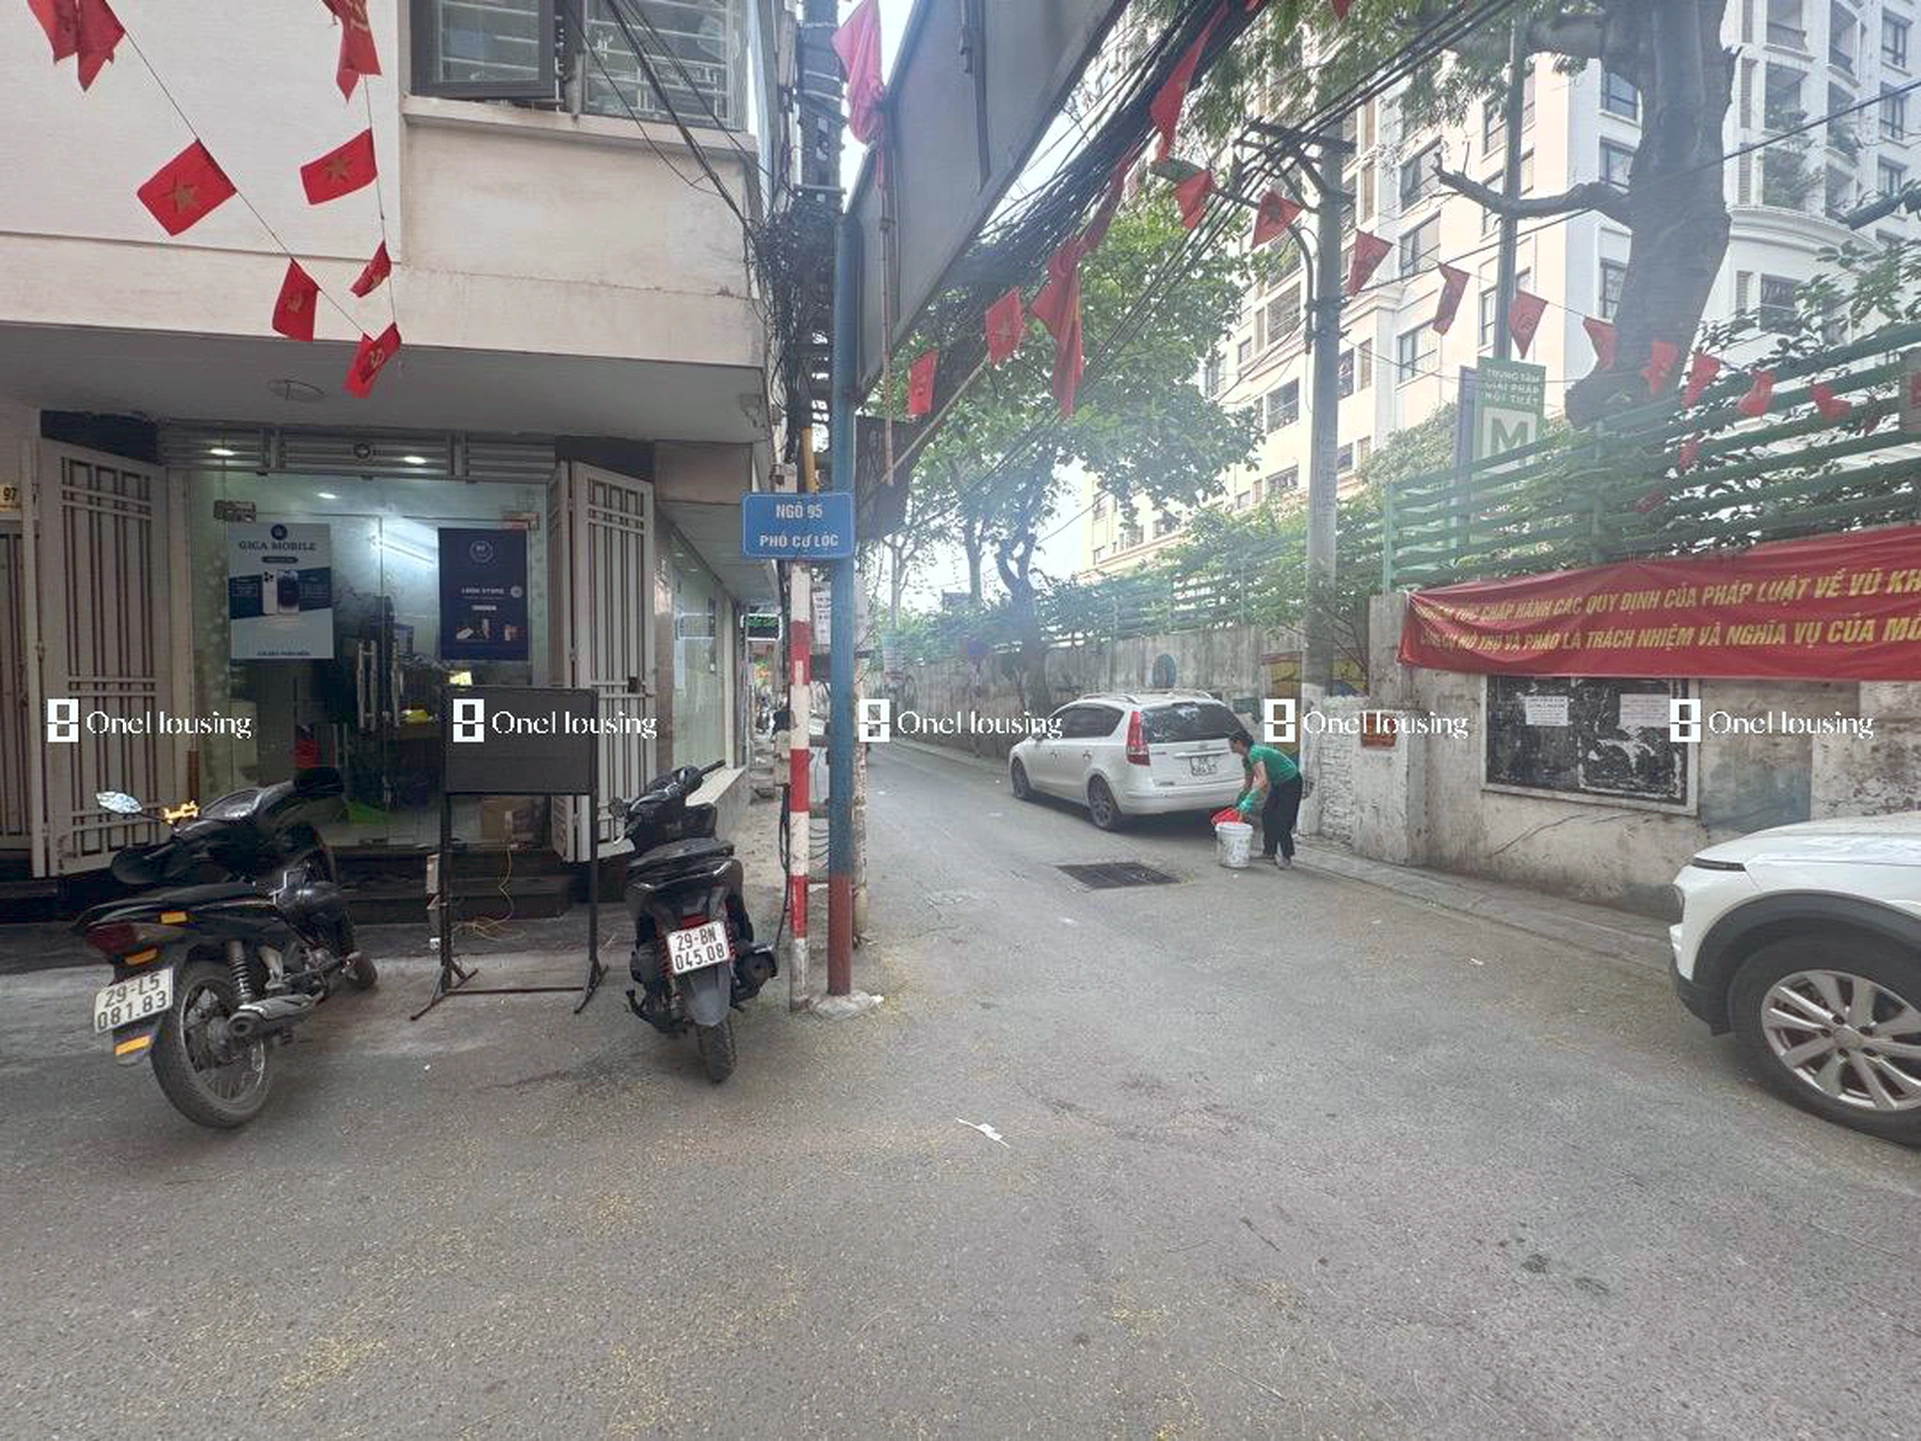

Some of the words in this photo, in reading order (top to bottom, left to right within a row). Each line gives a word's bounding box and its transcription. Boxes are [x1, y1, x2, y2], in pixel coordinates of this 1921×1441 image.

[1490, 417, 1529, 454] M
[3, 486, 17, 501] 97
[776, 501, 803, 519] NGÕ
[807, 503, 824, 519] 95
[271, 541, 316, 551] MOBILE
[1553, 595, 1583, 615] CÁC
[1586, 595, 1619, 615] QUY
[1620, 590, 1661, 616] ĐỊNH
[1663, 581, 1697, 609] CỦA
[1701, 579, 1753, 606] PHÁP
[1756, 574, 1811, 606] LUẬT
[1814, 568, 1847, 599] VỀ
[1848, 567, 1884, 596] VŨ
[1562, 629, 1582, 649] LÀ
[1586, 626, 1635, 649] TRÁCH
[1636, 624, 1695, 651] NHIỆM
[1698, 621, 1721, 647] VÀ
[1726, 619, 1787, 646] NGHĨA
[1794, 621, 1823, 649] VỤ
[1827, 612, 1876, 643] CỦA
[675, 926, 717, 952] 29-BN
[675, 942, 725, 971] 045.08
[104, 972, 161, 1009] 29-L5
[97, 990, 167, 1030] 081.83
